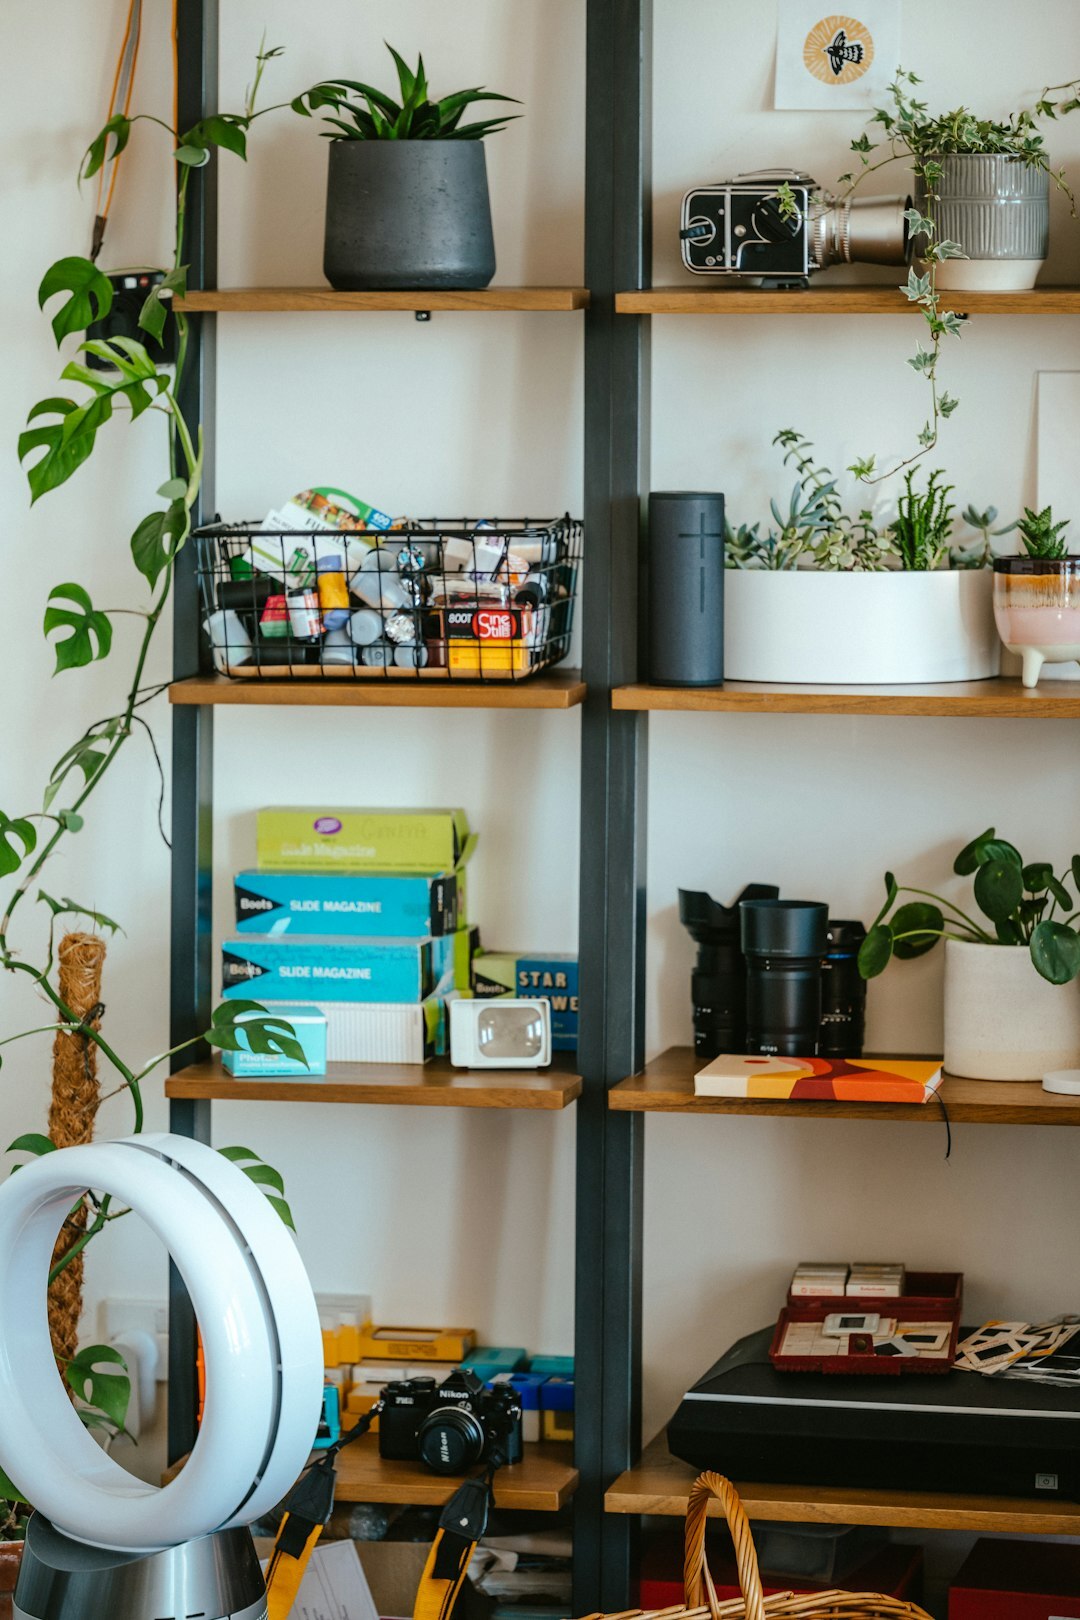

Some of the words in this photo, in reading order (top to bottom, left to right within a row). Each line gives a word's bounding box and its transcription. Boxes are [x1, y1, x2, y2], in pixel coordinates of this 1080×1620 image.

[373, 512, 390, 527] 400
[448, 613, 473, 624] 800T
[240, 898, 273, 911] Boots
[290, 899, 320, 912] SLIDE
[323, 900, 382, 913] MAGAZINE
[229, 963, 262, 977] Boots
[278, 966, 311, 978] SLIDE
[312, 966, 372, 980] MAGAZINE
[519, 971, 567, 988] STAR
[476, 983, 505, 994] Boots
[439, 1390, 470, 1399] Nikon
[441, 1432, 449, 1463] Nikon
